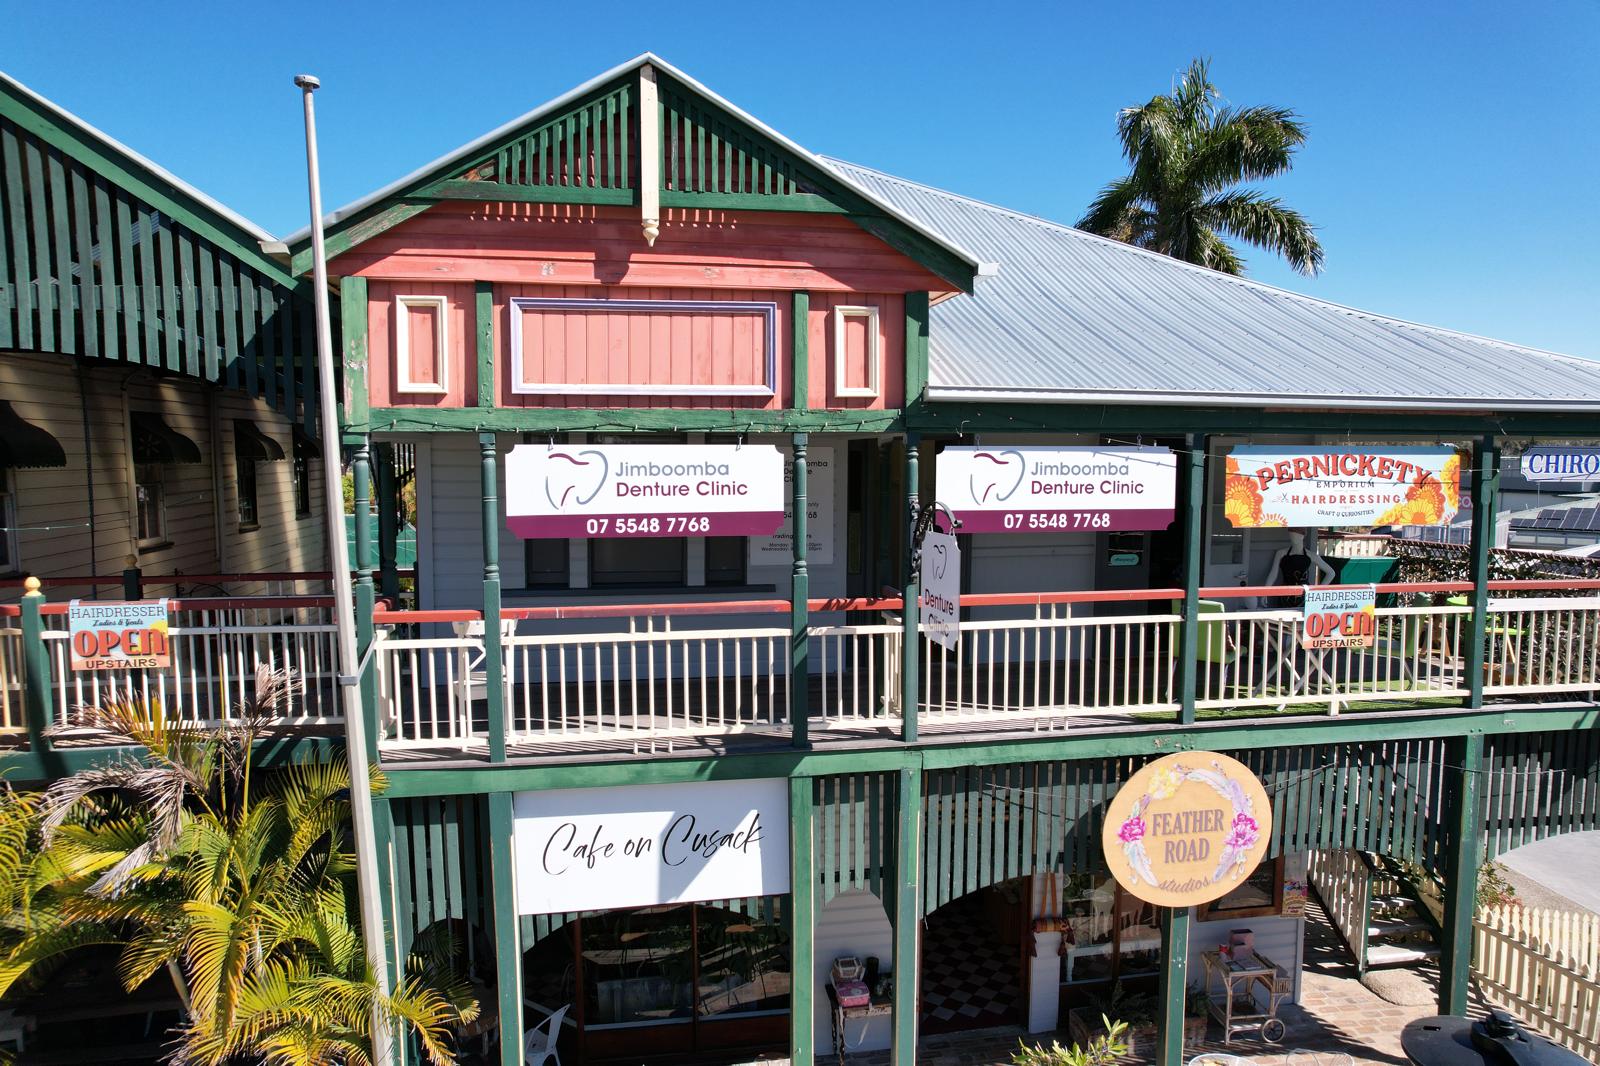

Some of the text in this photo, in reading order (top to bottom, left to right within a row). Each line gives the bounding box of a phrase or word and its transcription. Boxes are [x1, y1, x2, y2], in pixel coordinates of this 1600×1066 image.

[615, 461, 730, 478] Jimboomba
[1031, 462, 1129, 476] Jimboomba
[1256, 453, 1432, 491] PERNICKETY
[616, 480, 748, 498] Denture Clinic
[1031, 480, 1144, 495] Denture Clinic
[1316, 480, 1375, 488] EMPORIUM
[1291, 495, 1401, 504] HAIRDRESSING
[1003, 512, 1111, 528] 07 5548 7768
[1317, 509, 1335, 517] CRAFT
[586, 516, 711, 535] 07 5548 7768
[925, 588, 954, 616] Denture
[1307, 591, 1375, 602] HAIRDRESSER
[71, 606, 165, 619] HAIRDRESSER
[928, 613, 950, 637] Clinic
[1306, 612, 1374, 638] OPEN
[73, 628, 166, 658] OPEN
[1312, 639, 1364, 648] UPSTAIRS
[86, 658, 157, 669] UPSTAIRS
[1151, 808, 1225, 837] FEATHER
[542, 813, 765, 875] Cafe on Cusack
[1164, 838, 1211, 864] ROAD
[1158, 875, 1211, 893] studios
